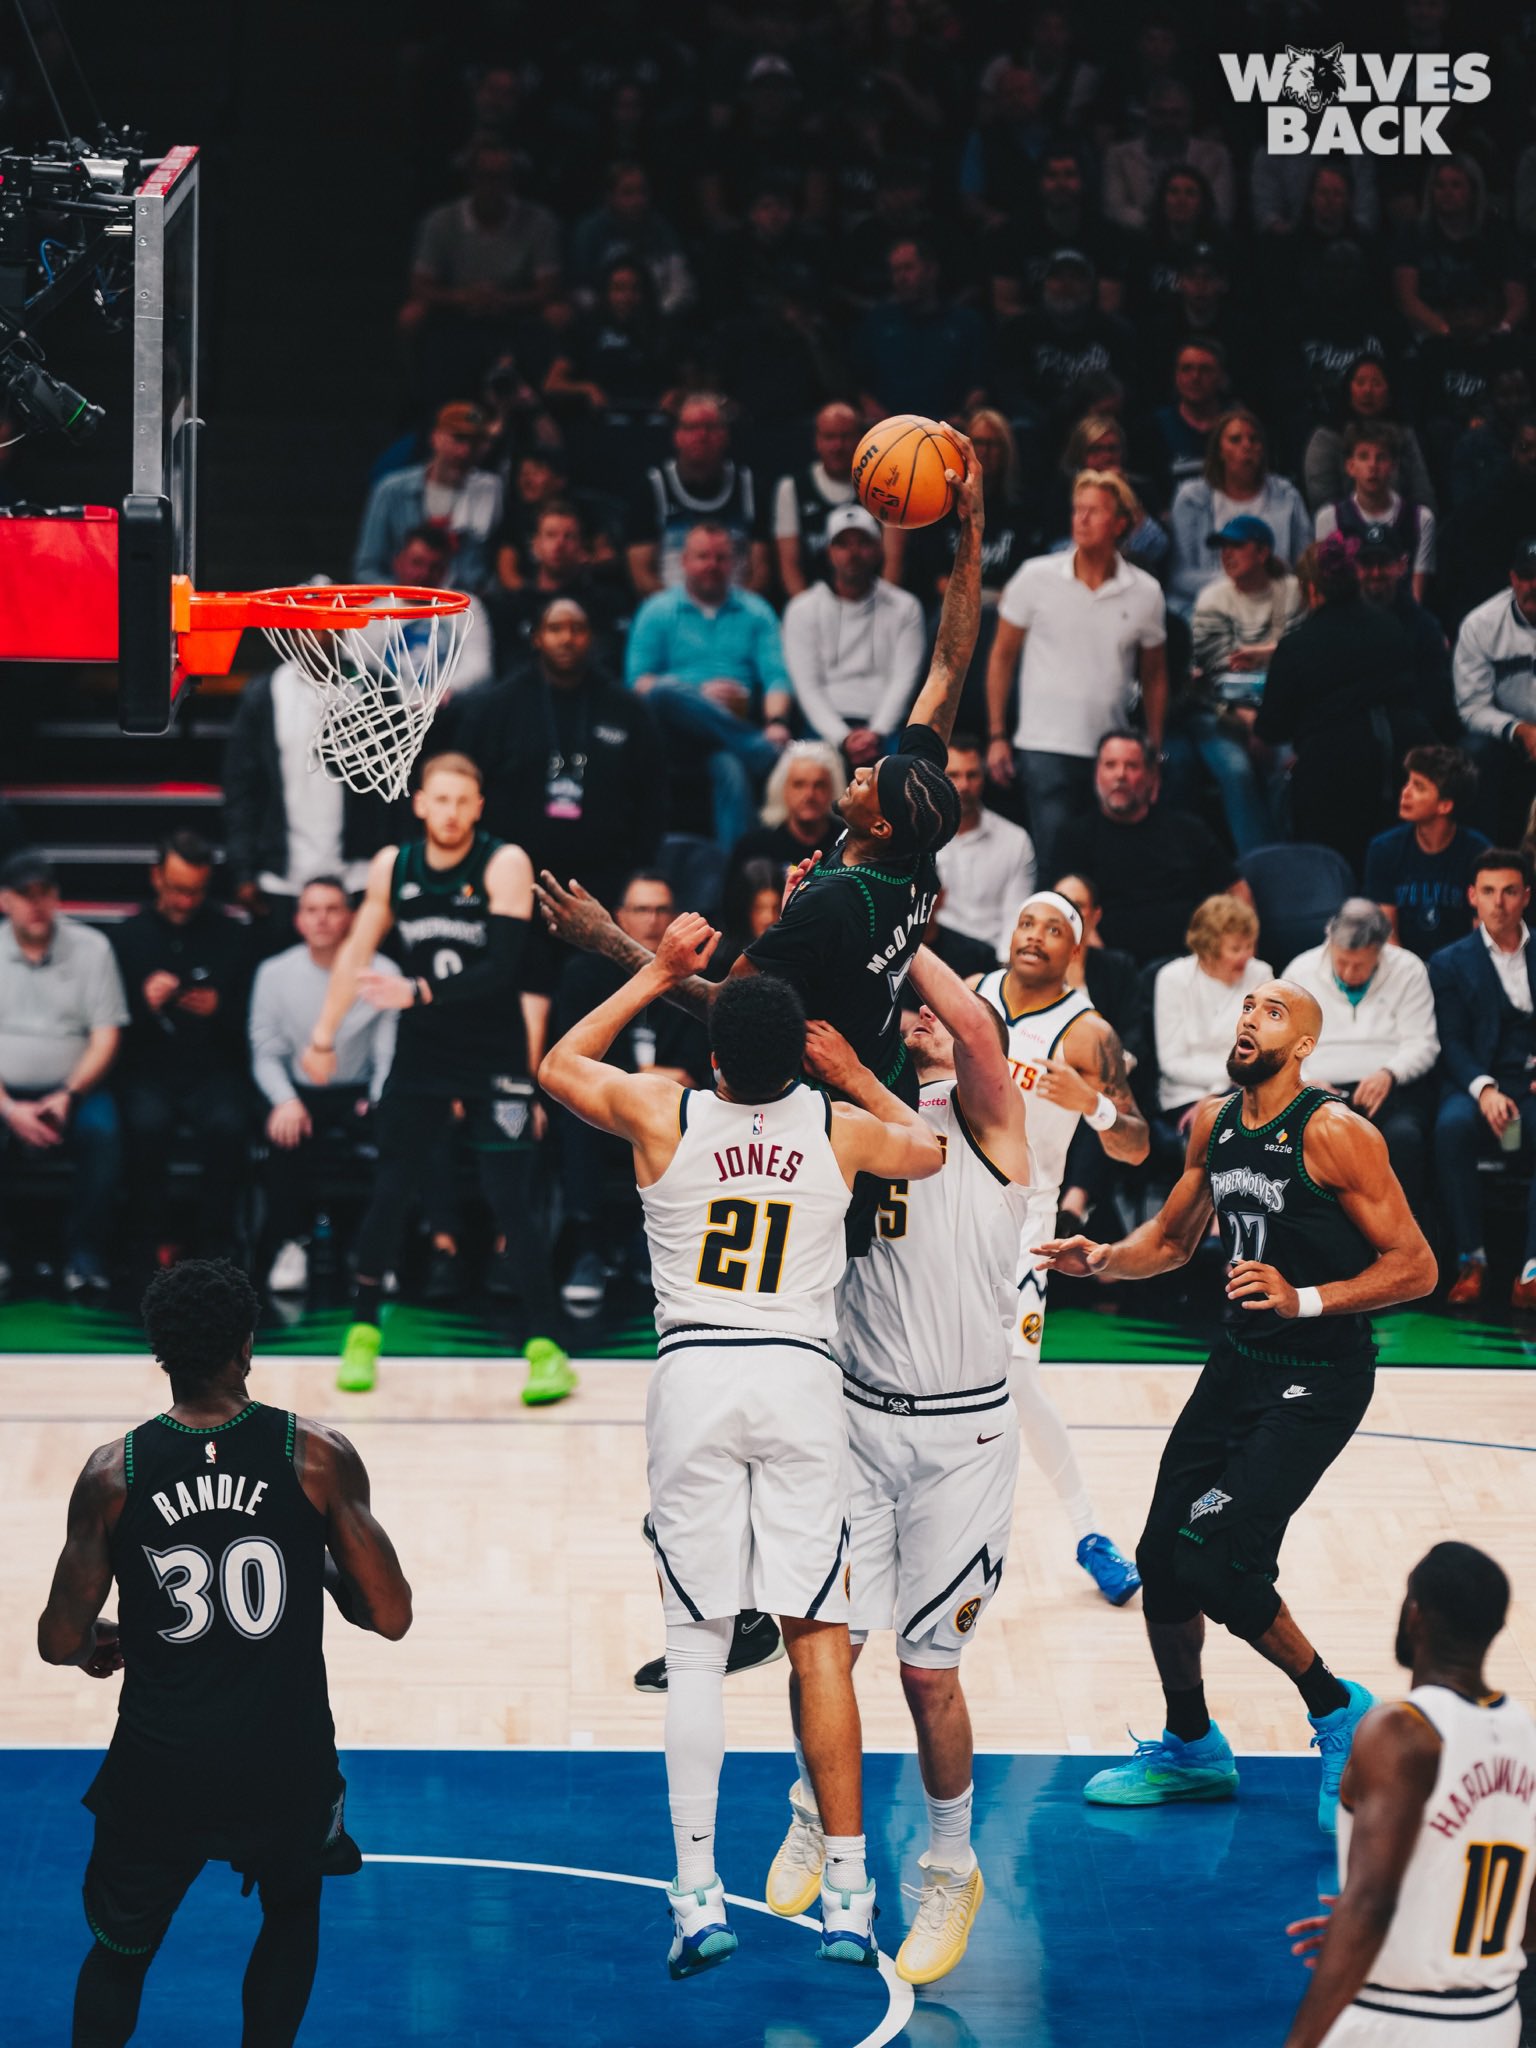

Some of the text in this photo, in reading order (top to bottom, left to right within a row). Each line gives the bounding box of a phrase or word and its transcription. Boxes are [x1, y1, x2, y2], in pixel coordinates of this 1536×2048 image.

[714, 1143, 804, 1183] JONES
[1264, 1143, 1293, 1154] sezzle
[1211, 1166, 1291, 1213] TIMBERWOLVES
[696, 1197, 793, 1294] 21
[152, 1474, 268, 1526] RANDLE
[141, 1536, 287, 1643] 30
[1452, 1840, 1529, 1959] 10
